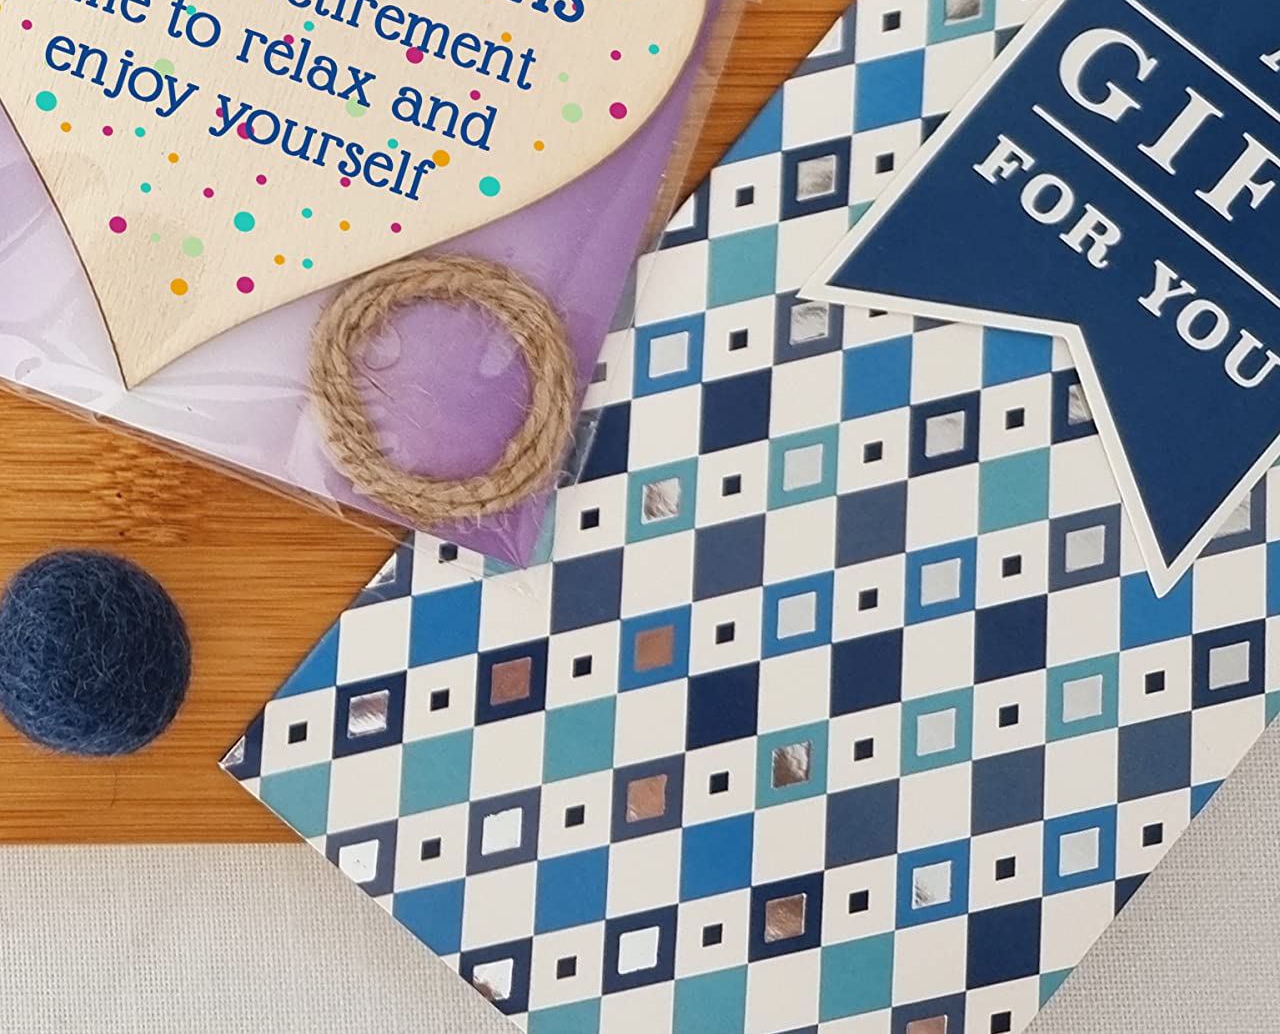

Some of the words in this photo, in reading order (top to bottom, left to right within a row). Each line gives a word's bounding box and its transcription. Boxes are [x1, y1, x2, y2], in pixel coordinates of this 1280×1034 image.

[45, 35, 200, 118] enjoy
[208, 94, 436, 201] yourself
[236, 28, 376, 108] relax
[391, 86, 497, 151] and
[1059, 28, 1280, 222] GIF
[972, 133, 1123, 269] FOR
[1137, 259, 1280, 389] YOU
